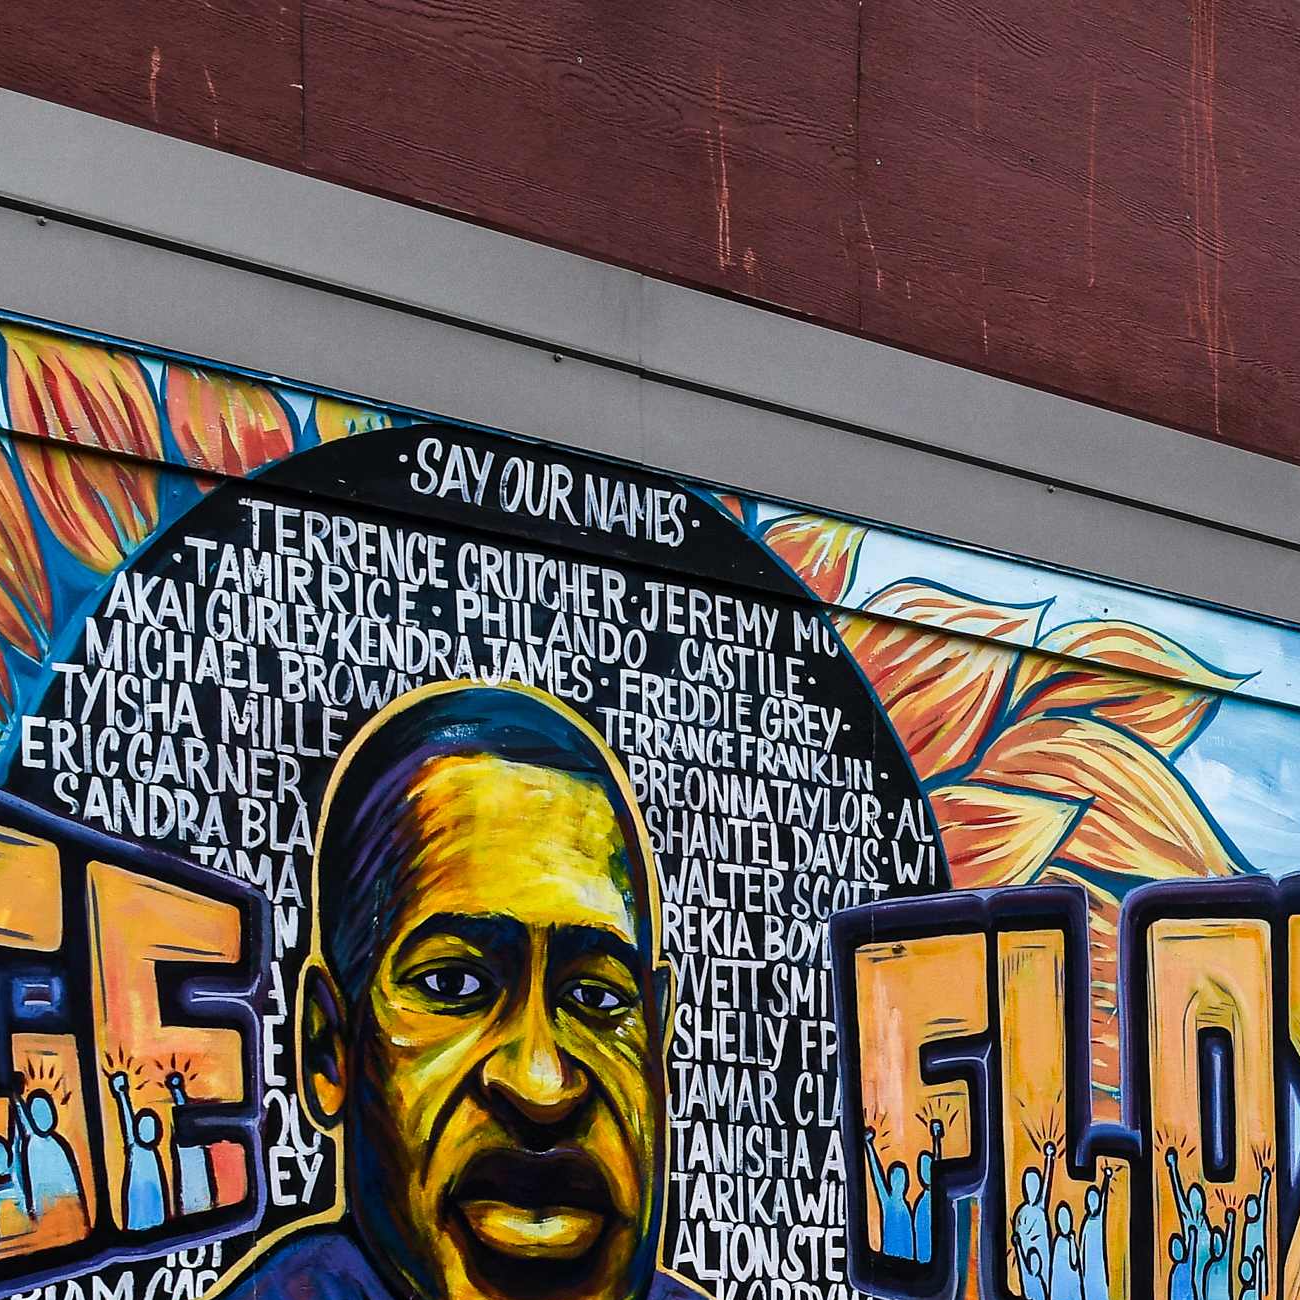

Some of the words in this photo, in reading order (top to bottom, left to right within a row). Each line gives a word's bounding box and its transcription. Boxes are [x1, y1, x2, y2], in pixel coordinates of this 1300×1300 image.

[410, 437, 495, 506] SAY
[500, 456, 581, 526] OUR
[584, 473, 687, 548] NAMES
[239, 498, 448, 589] TERRENCE
[457, 542, 628, 624] CRUTCHER
[641, 581, 779, 651] JEREMY
[86, 617, 269, 693] MICHAEL
[184, 536, 317, 608] TAMIR
[322, 564, 420, 629] RICE
[455, 589, 647, 669] PHILANDO
[679, 638, 805, 701] CASTILE
[103, 570, 196, 634] AKAI
[205, 589, 333, 656] GURLEY
[337, 611, 479, 683] KENDRA
[477, 635, 593, 703] JAMES
[619, 668, 752, 733] FREDDIE
[760, 697, 842, 753] GREY
[52, 662, 205, 739] TYISHA
[220, 688, 348, 758] MILLE
[596, 706, 735, 768] TERRANCE
[741, 734, 873, 791] FRANKLIN
[21, 716, 120, 778] ERIC
[127, 732, 308, 808] GARNER
[628, 755, 773, 820] BREONNA
[771, 780, 884, 840] TAYLOR
[894, 798, 933, 842] AL
[54, 772, 230, 846] SANDRA
[238, 797, 315, 855] BLA
[646, 805, 789, 871] SHANTEL
[792, 826, 878, 882] DAVIS
[891, 840, 935, 886] WI
[654, 854, 788, 916] WALTER
[663, 902, 756, 958] REKIA
[768, 963, 827, 1017] SMI
[673, 1004, 788, 1071] SHELLY
[667, 1062, 786, 1127] JAMAR
[671, 1121, 813, 1180] TANISHA
[671, 1172, 795, 1225] TARIKA
[673, 1220, 780, 1280] ALTON
[781, 1225, 845, 1283] STE
